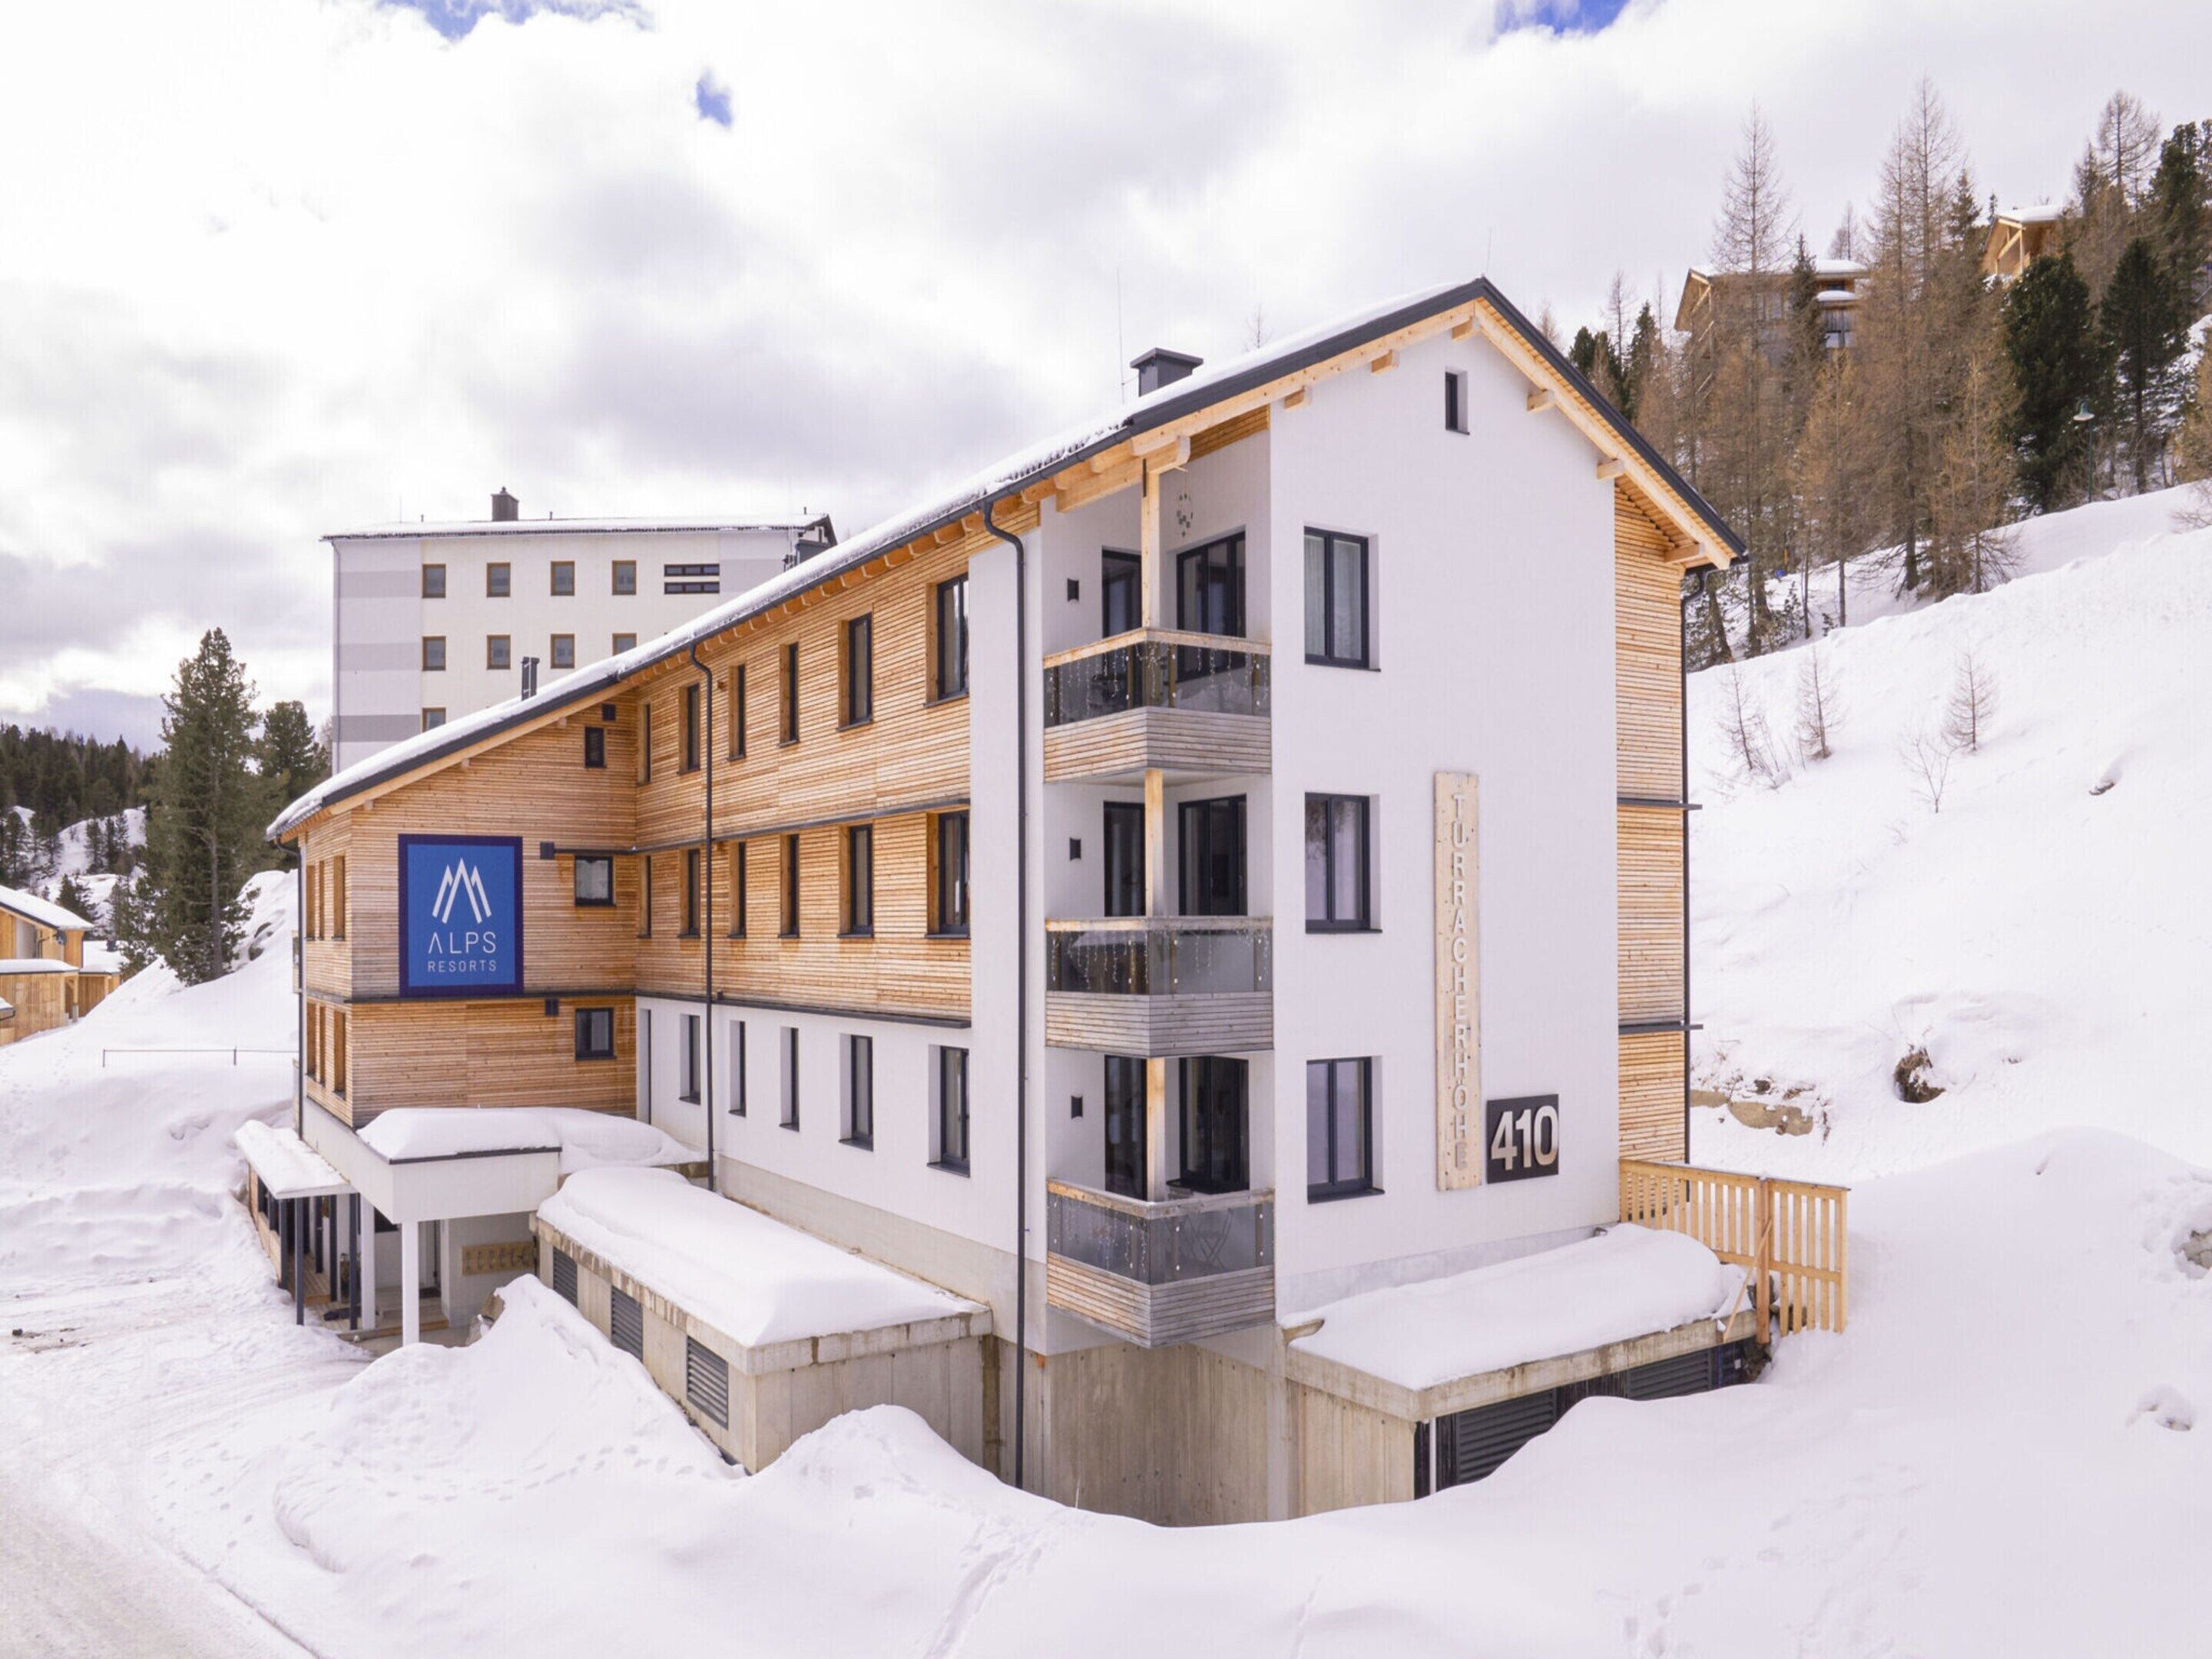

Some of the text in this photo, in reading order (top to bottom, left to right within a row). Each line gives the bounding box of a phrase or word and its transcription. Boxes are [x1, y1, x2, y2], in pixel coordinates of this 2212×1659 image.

[428, 931, 497, 954] ALPS
[428, 959, 497, 973] RESORTS
[1490, 1104, 1559, 1171] 410
